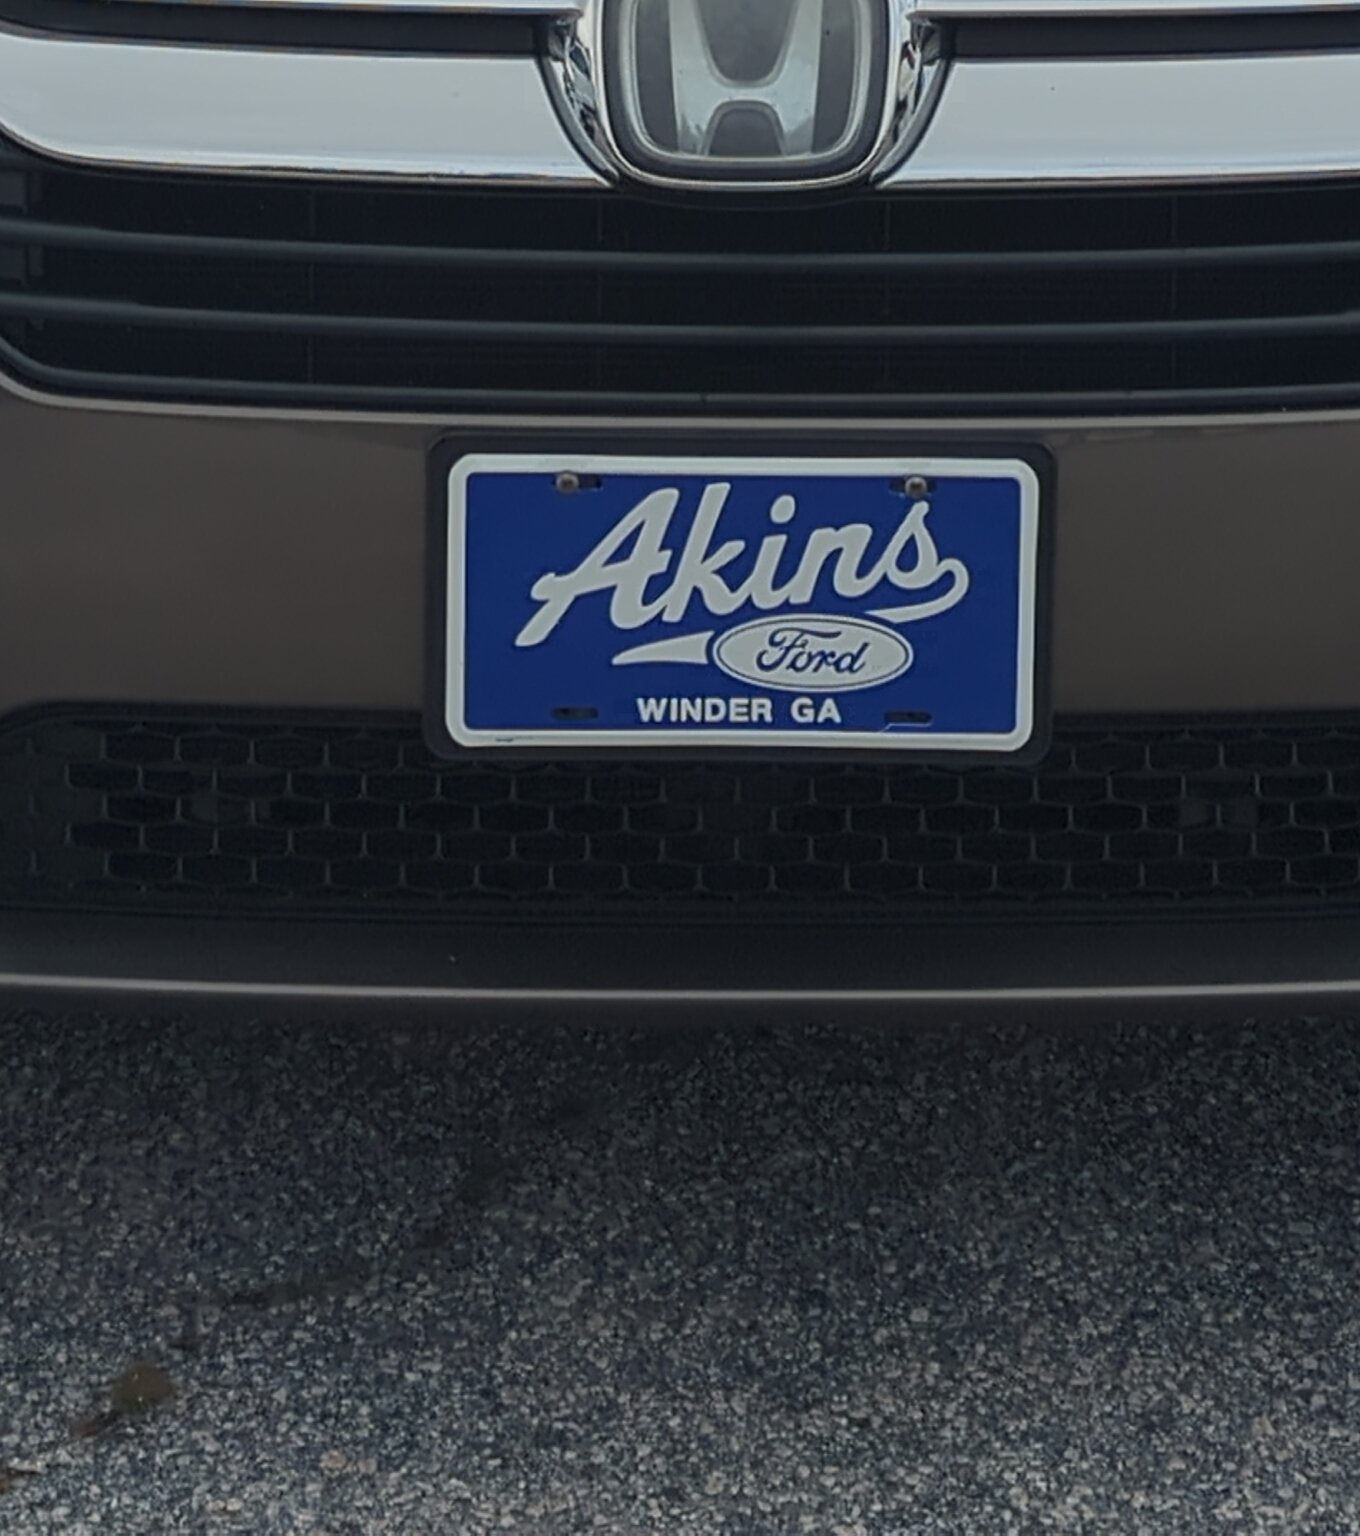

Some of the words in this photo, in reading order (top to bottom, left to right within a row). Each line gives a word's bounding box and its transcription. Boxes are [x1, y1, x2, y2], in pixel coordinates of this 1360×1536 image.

[515, 482, 970, 647] Akins
[755, 626, 871, 675] Ford
[636, 697, 773, 723] WINDER
[790, 697, 842, 724] GA
